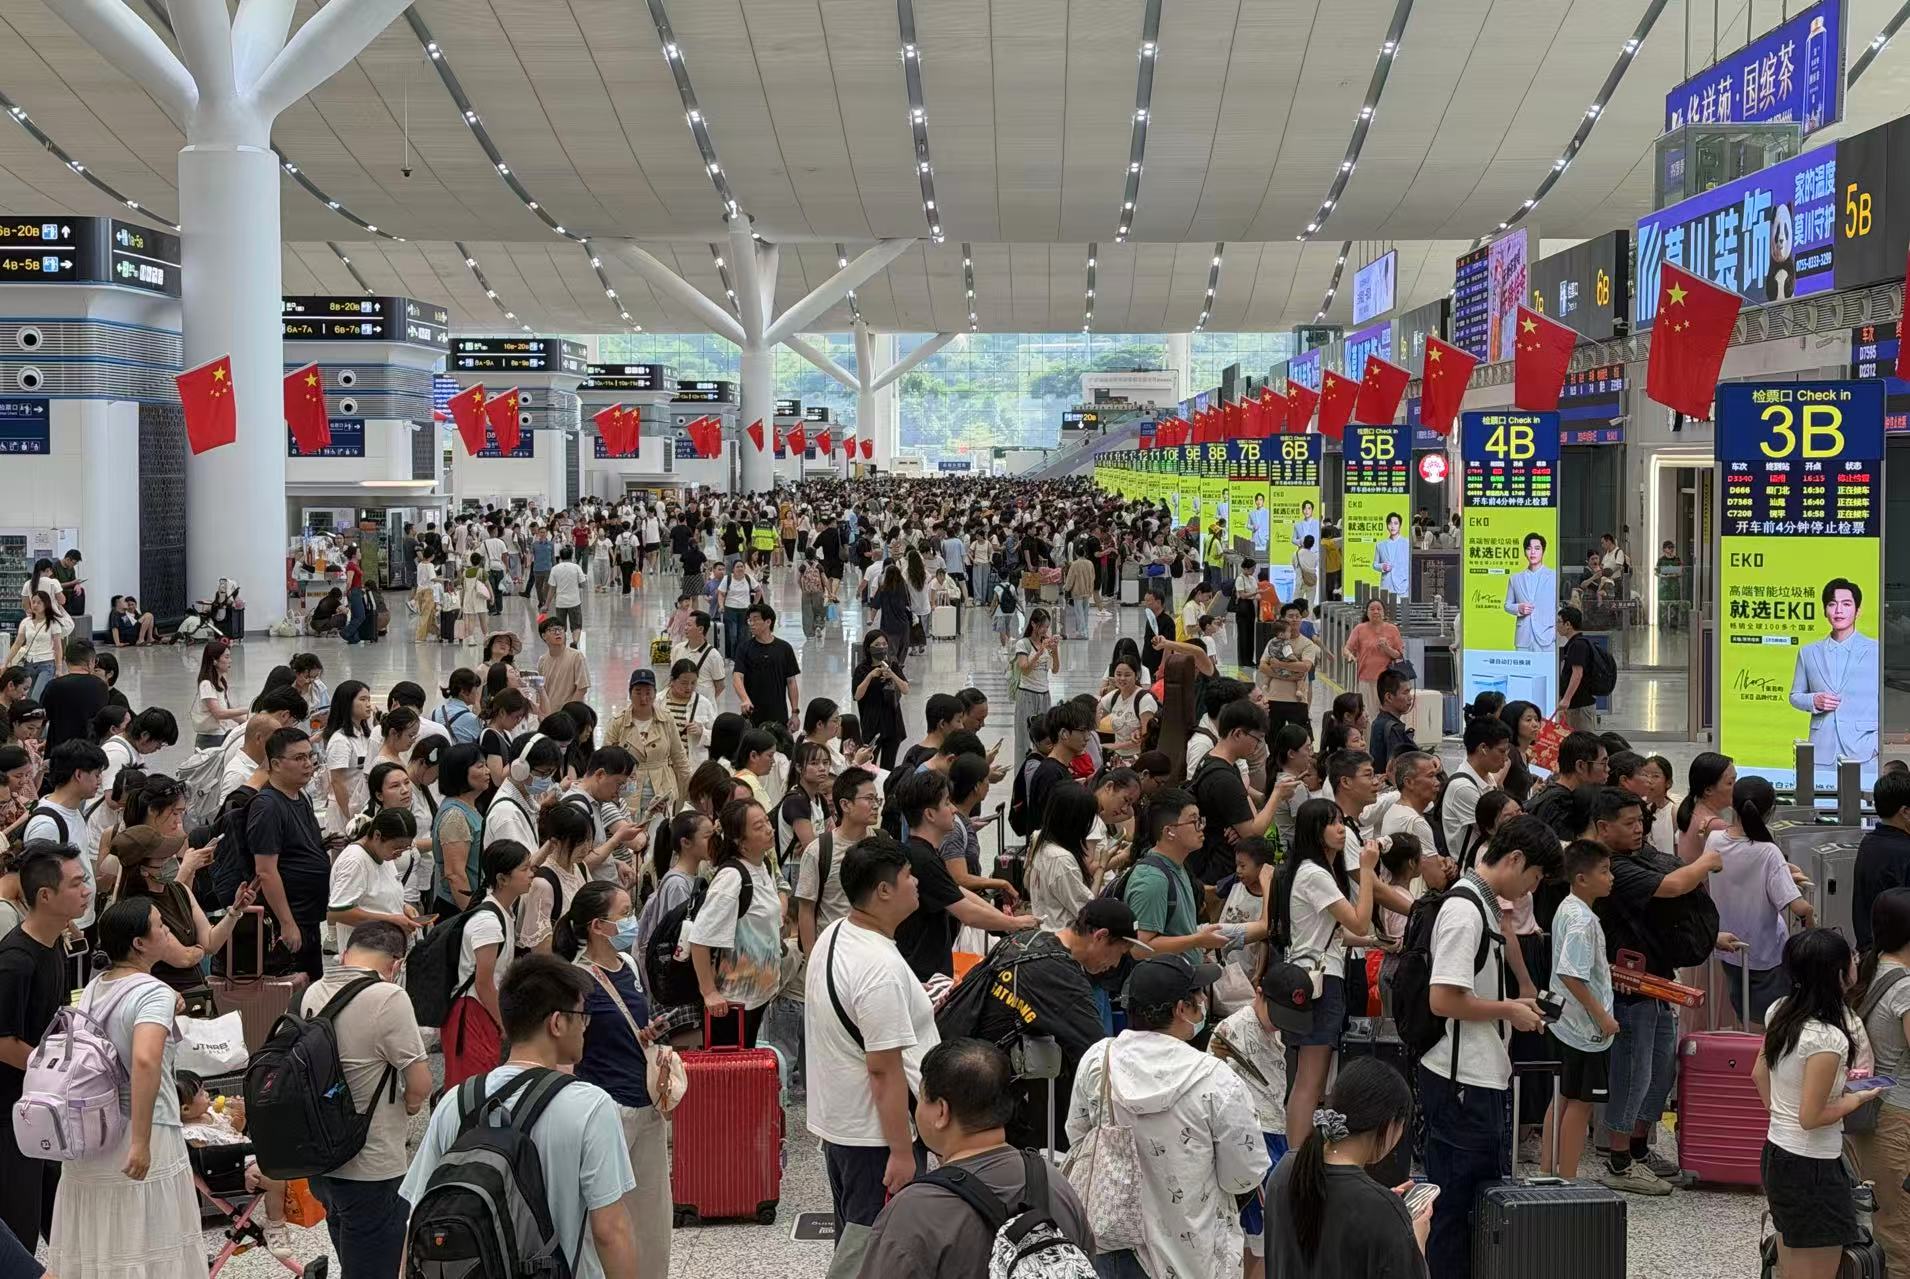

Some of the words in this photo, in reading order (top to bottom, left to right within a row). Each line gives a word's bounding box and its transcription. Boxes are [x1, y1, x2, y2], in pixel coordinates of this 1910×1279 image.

[1795, 160, 1836, 207] 家的温度
[1845, 183, 1872, 239] 5B
[2, 258, 41, 271] 4B-5B
[1596, 268, 1610, 307] 6B
[329, 302, 360, 311] 8B-20B
[286, 325, 313, 334] 6A-7A
[334, 325, 360, 334] 6B-7B
[1752, 389, 1793, 404] 检票口
[1797, 389, 1837, 401] Check
[1840, 389, 1851, 401] in
[1508, 416, 1532, 424] Check
[1533, 416, 1541, 424] in
[1759, 404, 1845, 459] 3B
[1360, 435, 1395, 460] 5B
[1484, 425, 1536, 460] 4B
[1208, 446, 1227, 460] 8B
[1238, 443, 1260, 460] 7B
[1281, 440, 1309, 460] 6B
[1731, 462, 1748, 471] 车次
[1348, 500, 1363, 509] EKO
[1469, 517, 1490, 527] EKO
[1735, 521, 1865, 534] 开车前4分钟停止检票
[1469, 546, 1520, 559] 就选EKO
[1730, 552, 1764, 568] EKO
[1729, 585, 1816, 598] 高端智能垃圾桶
[1729, 599, 1816, 621] 就选EKO
[1729, 622, 1816, 632] 畅销全球100多个国家
[1740, 693, 1754, 701] EKO
